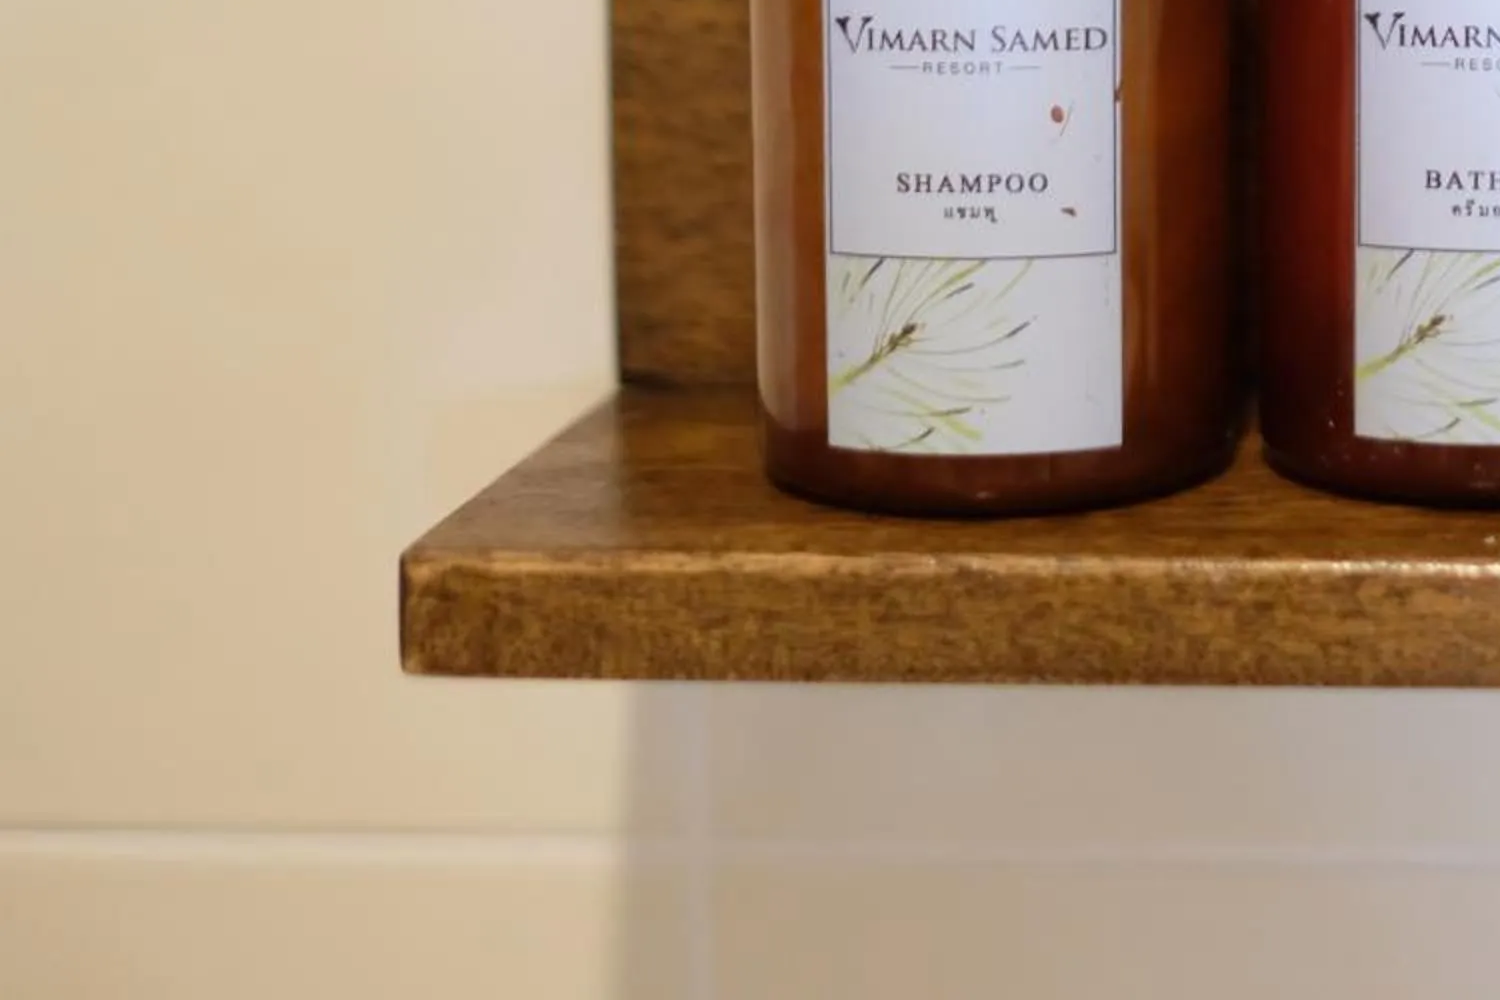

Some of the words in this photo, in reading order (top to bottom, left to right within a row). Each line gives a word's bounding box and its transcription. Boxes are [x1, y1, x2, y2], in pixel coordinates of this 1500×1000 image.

[835, 15, 976, 53] VIMARN
[991, 25, 1108, 51] SAMED
[922, 61, 1004, 75] RESORT
[896, 172, 1049, 194] SHAMPOO
